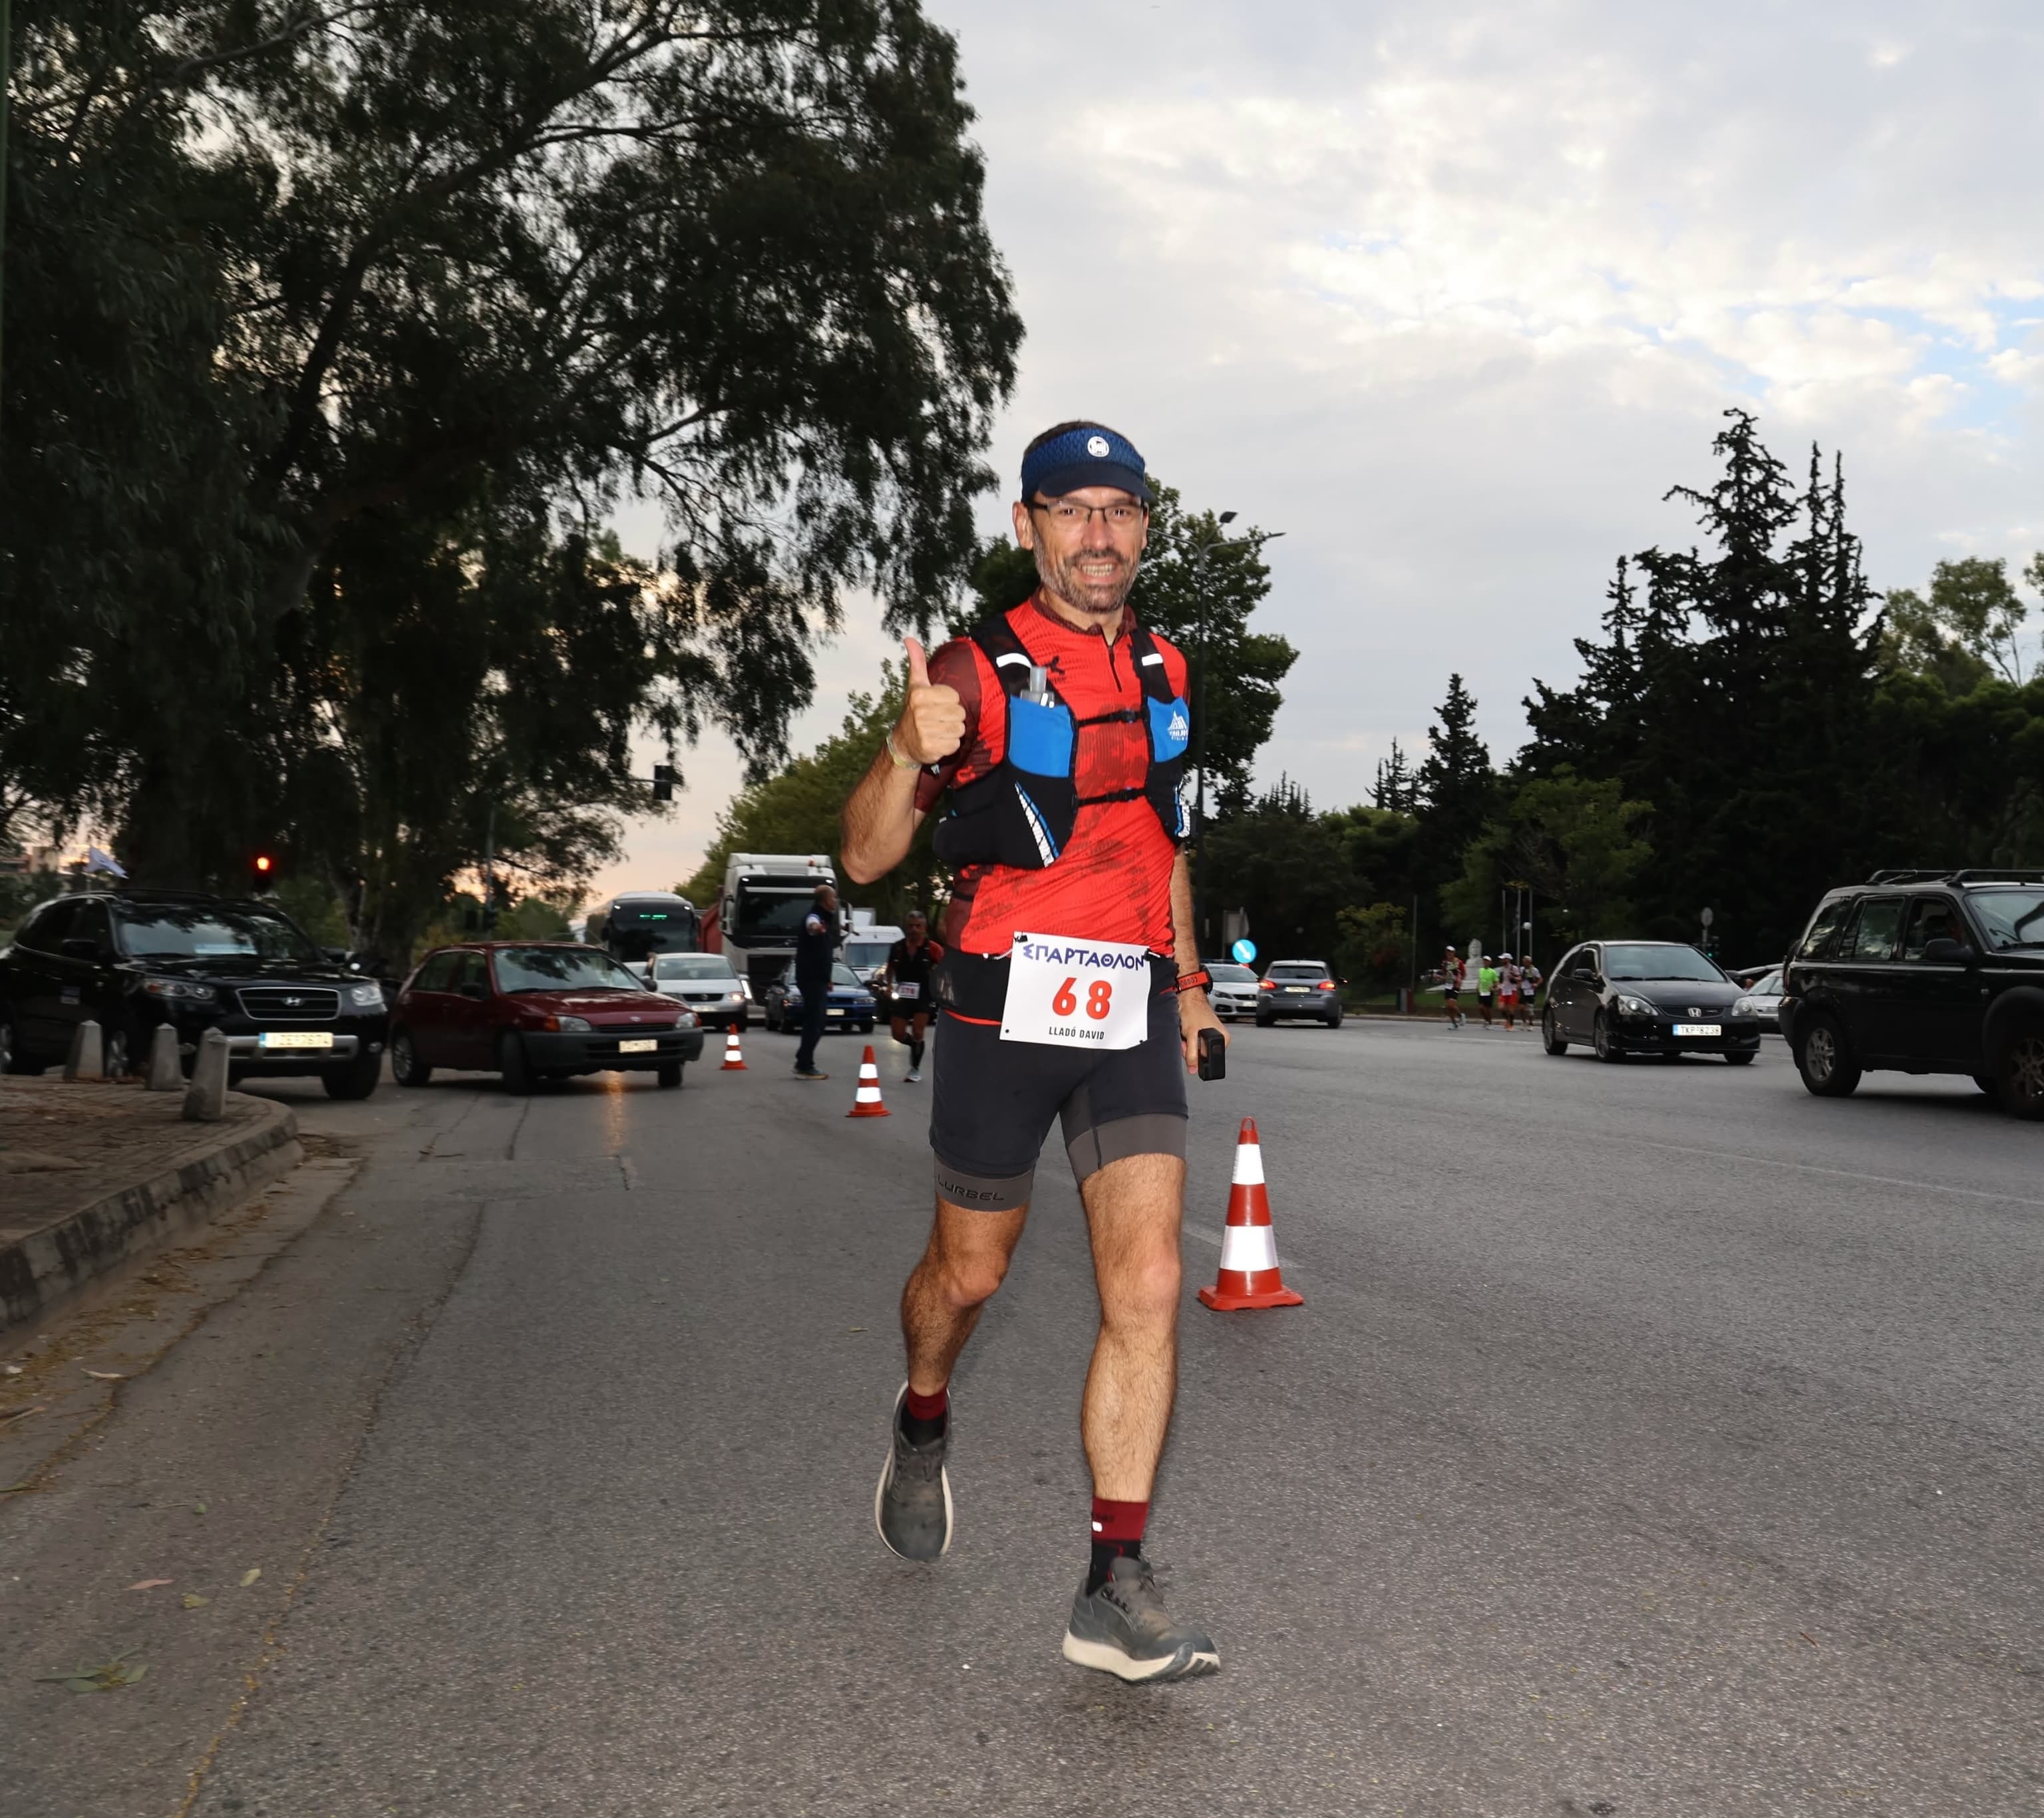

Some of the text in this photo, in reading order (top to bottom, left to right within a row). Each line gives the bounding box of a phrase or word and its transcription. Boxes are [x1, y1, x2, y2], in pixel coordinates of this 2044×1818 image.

[1052, 977, 1112, 1020] 68
[1049, 1026, 1105, 1040] LLADÓ DAVID
[937, 1174, 1005, 1201] LURBEL
